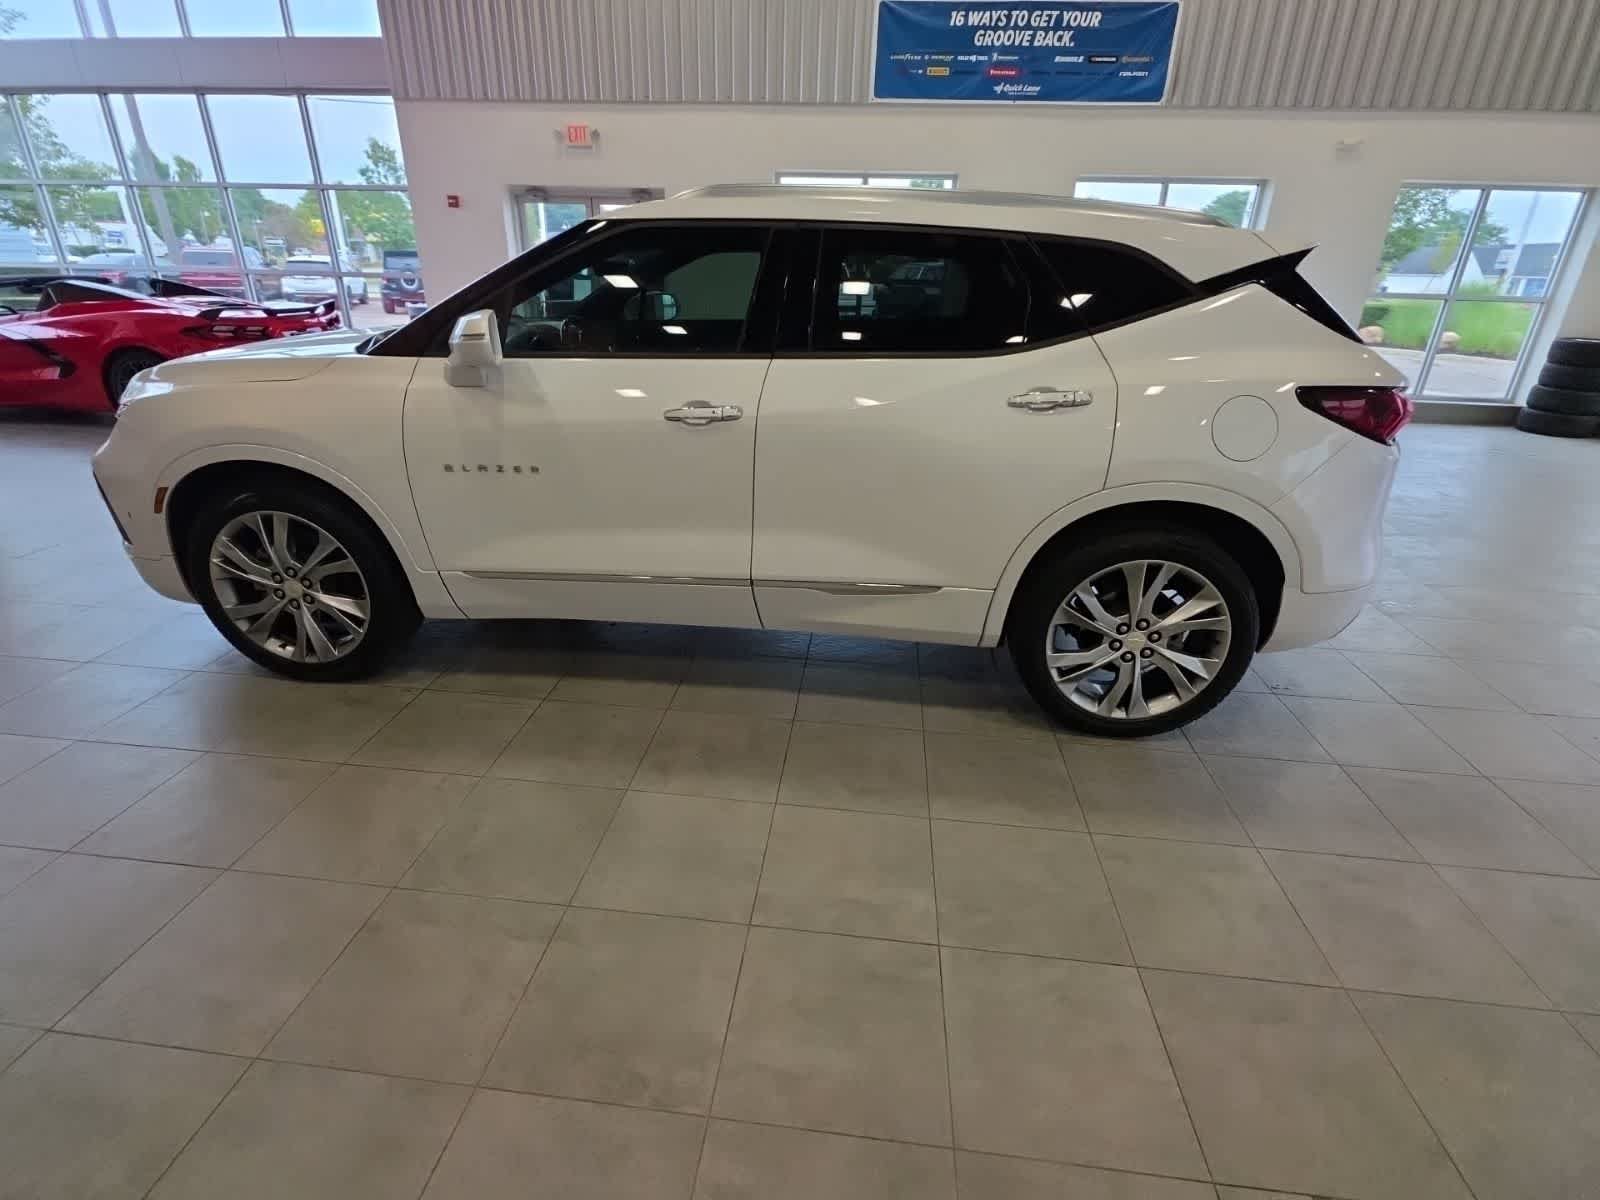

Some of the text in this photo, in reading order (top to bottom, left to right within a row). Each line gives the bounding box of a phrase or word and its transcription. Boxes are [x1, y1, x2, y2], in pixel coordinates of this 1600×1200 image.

[950, 10, 1102, 27] 16 WAYS TO GET YOUR
[974, 30, 1075, 47] GROOVE BACK.
[568, 126, 587, 143] EXIT
[443, 463, 541, 474] BLAZER
